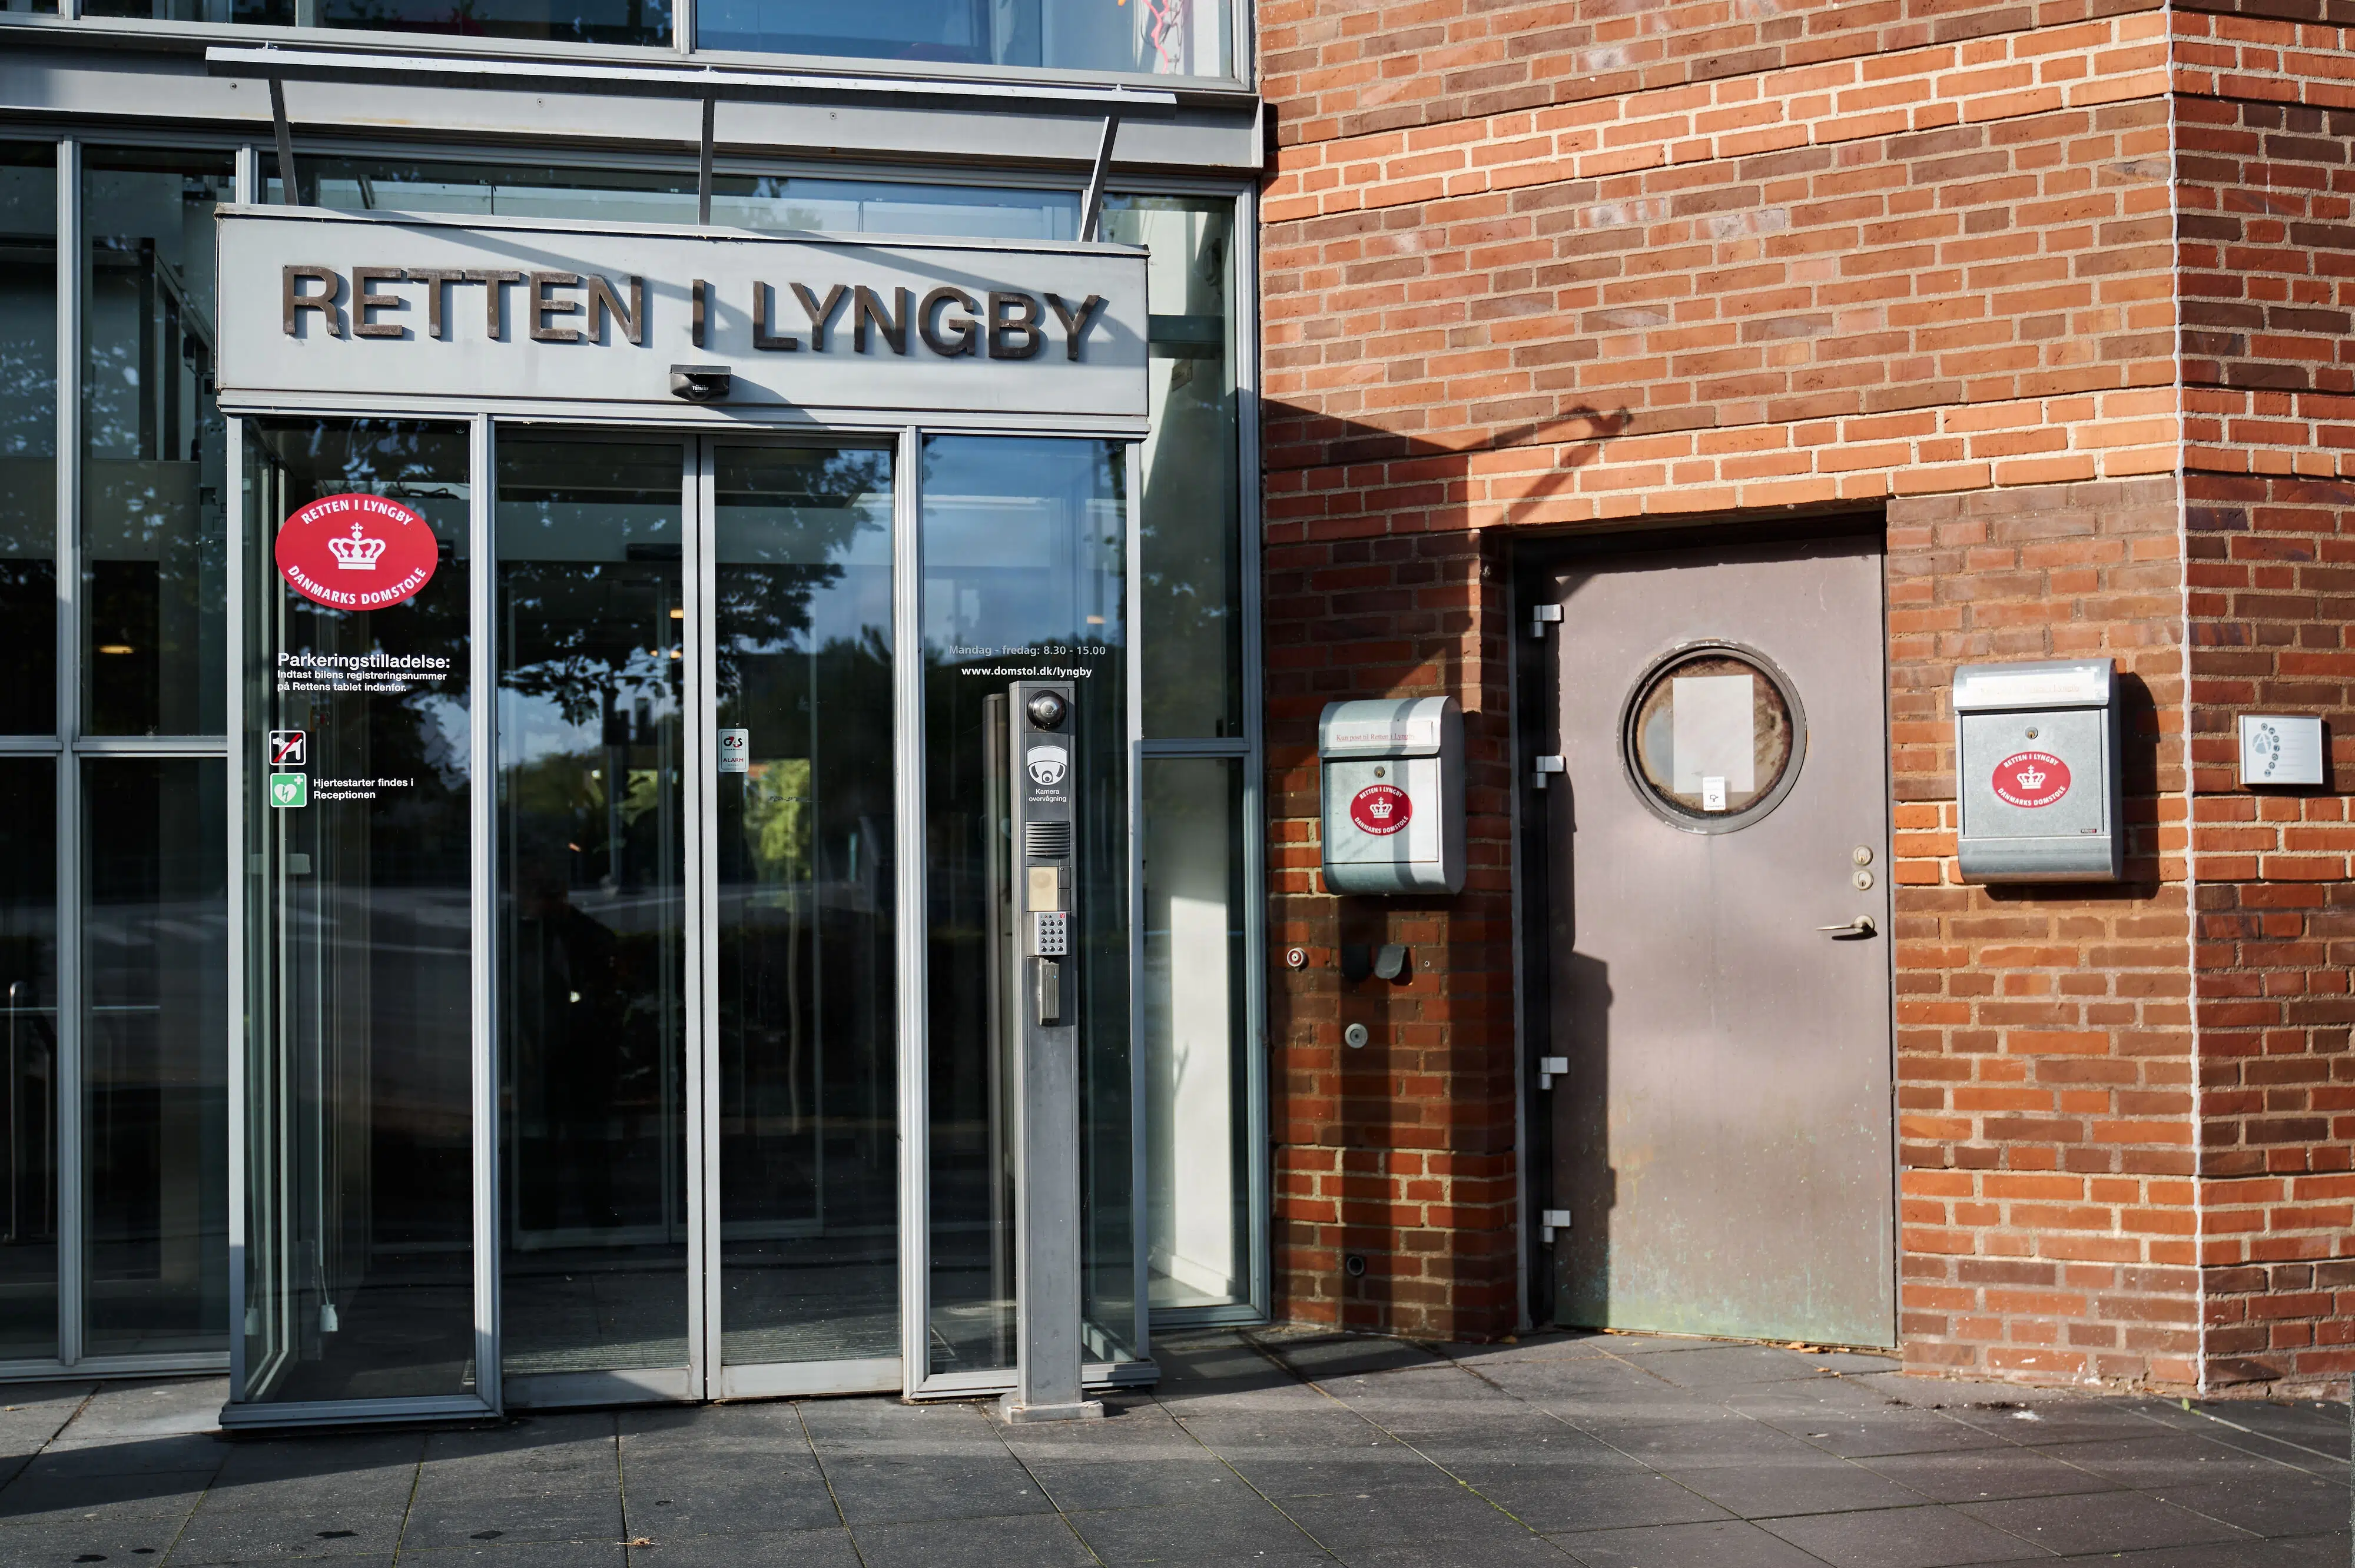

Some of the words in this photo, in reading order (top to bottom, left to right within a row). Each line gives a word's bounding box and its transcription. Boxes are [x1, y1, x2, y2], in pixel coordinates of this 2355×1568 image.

[283, 265, 643, 344] RETTEN
[692, 279, 705, 347] I
[753, 281, 1101, 360] LYNGBY
[301, 500, 349, 524] RETTEN
[354, 500, 359, 510] I
[364, 500, 413, 526] LYNGBY
[288, 565, 356, 604] DANMARKS
[361, 567, 426, 604] DOMSTOLE
[949, 646, 991, 656] Mandag
[1002, 645, 1040, 656] fredag:
[1043, 646, 1066, 655] 8.30
[1077, 646, 1106, 655] 15.00
[278, 653, 450, 670] Parkeringstilladelse:
[277, 670, 312, 679] Indtast
[314, 670, 344, 679] bilens
[347, 671, 447, 681] registreringsnummer
[961, 666, 1092, 677] www.domstol.dk/lyngby
[277, 682, 290, 692] på
[293, 682, 331, 691] Rettens
[333, 682, 361, 691] tablet
[364, 683, 407, 692] indenfor.
[2003, 754, 2027, 768] RETTEN
[2034, 754, 2059, 766] LYNGBY
[313, 779, 375, 788] Hjertestarter
[378, 778, 407, 786] findes
[411, 778, 413, 786] i
[313, 791, 376, 800] Receptionen
[1359, 787, 1378, 799] RETTEN
[1383, 786, 1403, 798] LYNGBY
[1998, 788, 2031, 806] DANMARKS
[2034, 785, 2066, 806] DOMSTOLE
[1354, 817, 1381, 833] DANMARKS
[1382, 816, 1408, 833] DOMSTOLE
